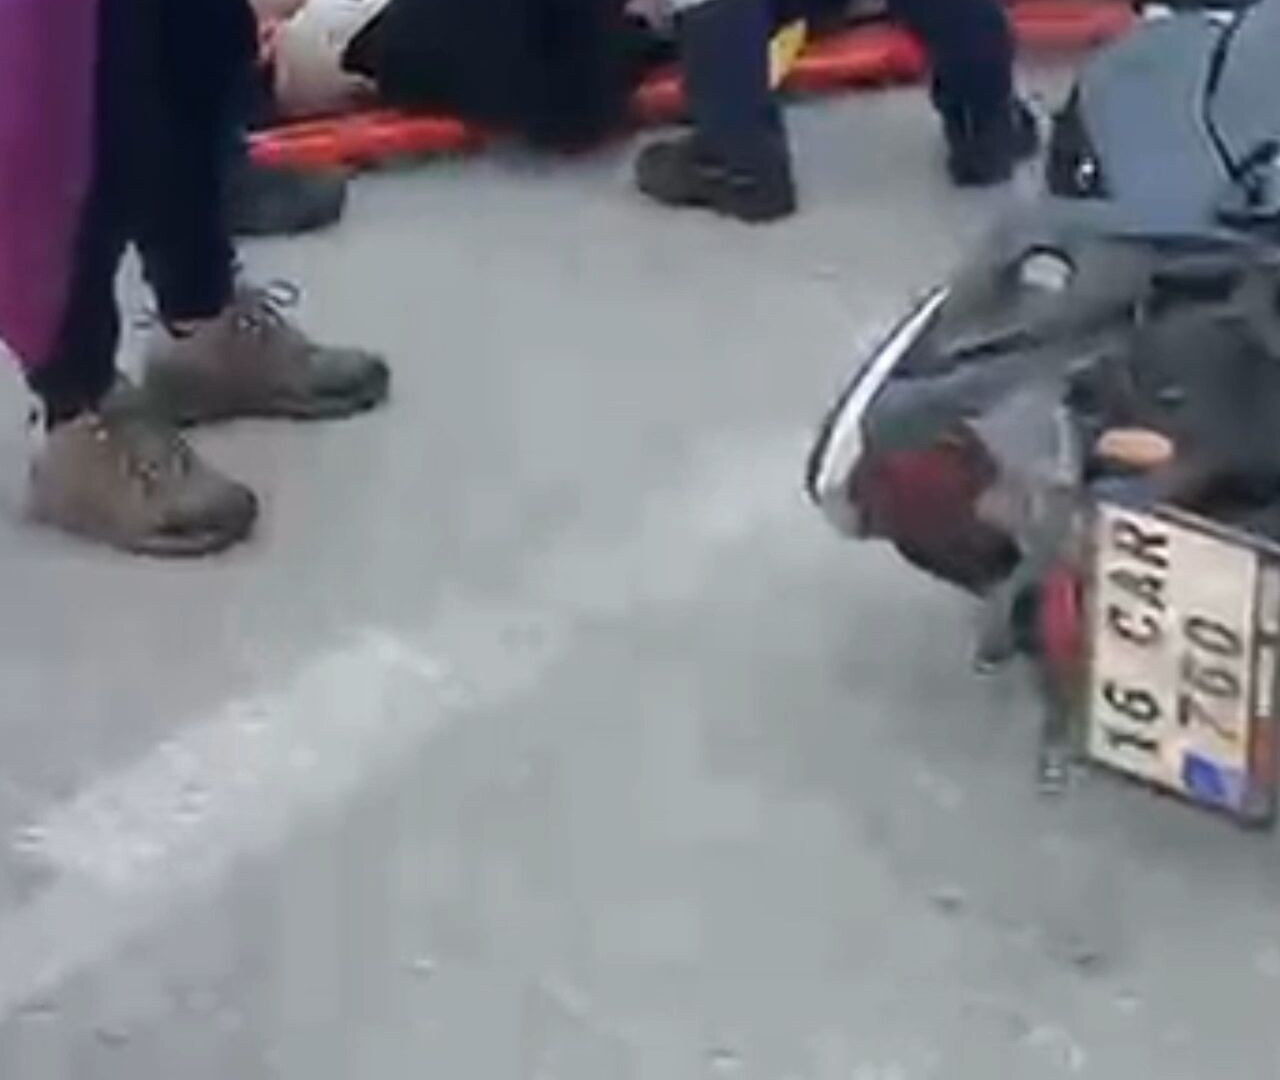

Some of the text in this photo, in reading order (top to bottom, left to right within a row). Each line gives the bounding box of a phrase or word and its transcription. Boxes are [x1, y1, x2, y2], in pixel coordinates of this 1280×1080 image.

[1101, 521, 1169, 756] 16 CAR
[1178, 616, 1243, 741] 760
